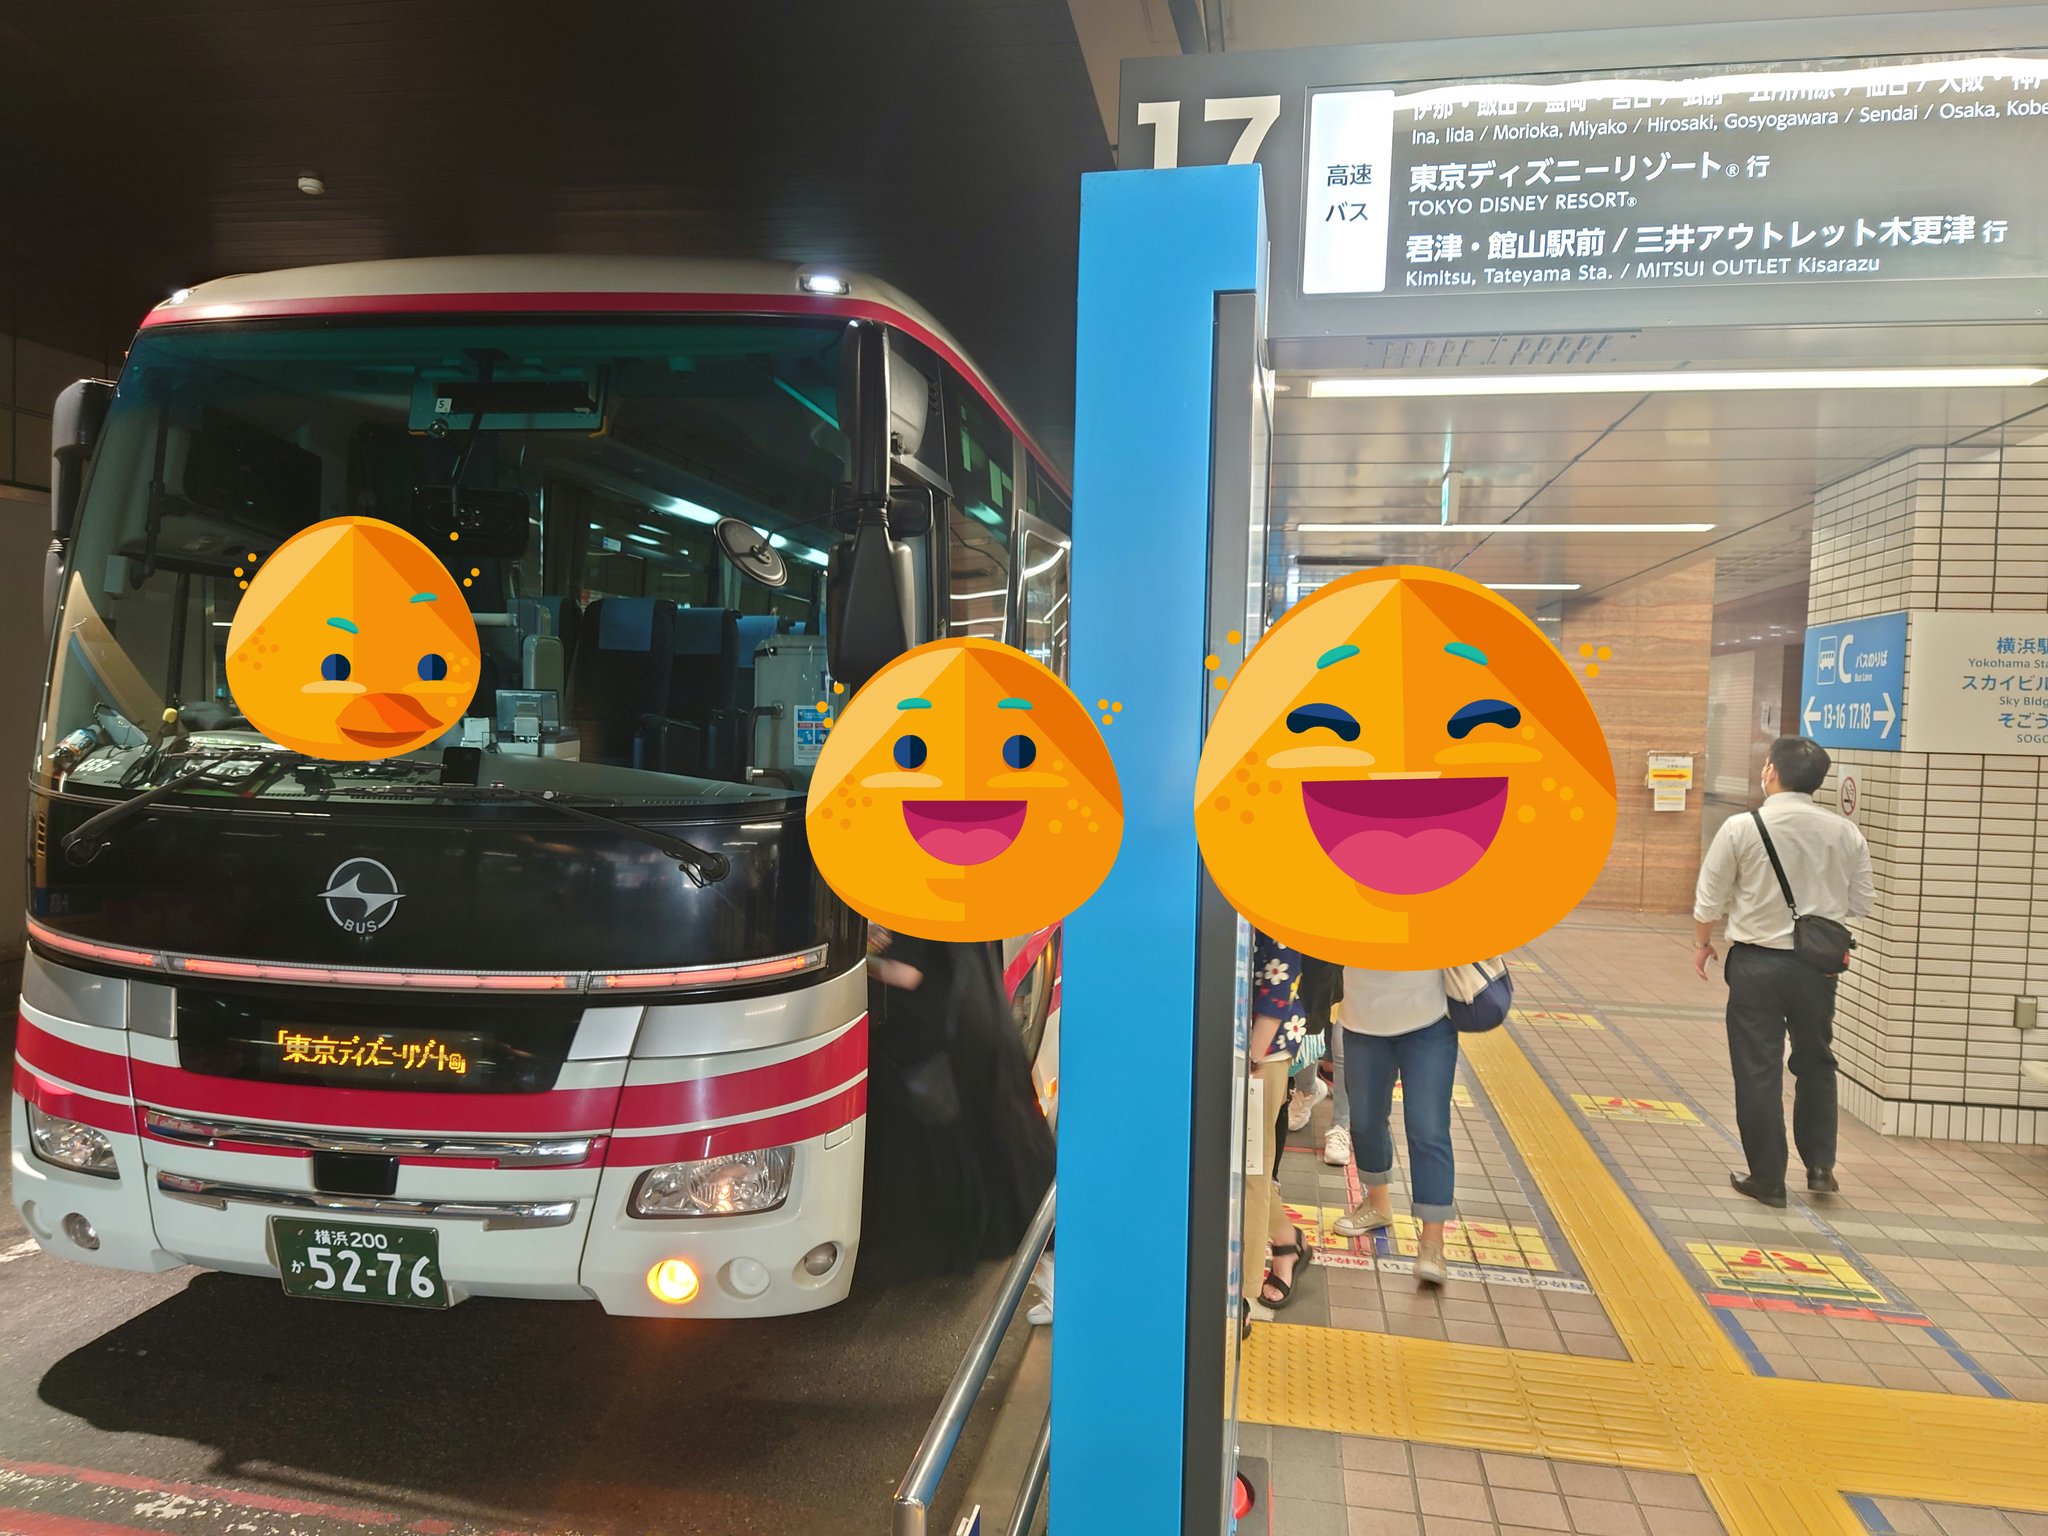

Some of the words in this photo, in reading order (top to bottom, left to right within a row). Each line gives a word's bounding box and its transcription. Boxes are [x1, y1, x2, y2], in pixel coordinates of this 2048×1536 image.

[1137, 94, 1282, 169] 17
[1412, 129, 1440, 145] Ina,
[1445, 126, 1474, 143] Iida
[1493, 122, 1563, 141] Morioka,
[1568, 118, 1628, 140] Miyako
[1647, 114, 1718, 133] Hirosaki,
[1724, 110, 1838, 132] Gosyogawara
[1859, 104, 1918, 123] Sendai
[1939, 101, 2001, 119] Osaka,
[1327, 163, 1373, 187] 高速
[1746, 154, 1771, 178] 行
[1325, 201, 1368, 222] バス
[1408, 198, 1472, 217] TOKYO
[1480, 194, 1549, 214] DISNEY
[1405, 227, 1606, 263] 君津・館山駅前
[1634, 214, 1976, 253] 三井アウトレット木更津
[1405, 269, 1477, 288] Kimitsu,
[1484, 266, 1571, 288] Tateyama
[1578, 264, 1613, 281] Sta.
[1636, 260, 1705, 279] MITSUI
[1712, 257, 1792, 276] OUTLET
[1798, 256, 1881, 275] Kisarazu
[1838, 634, 1854, 684] C
[1855, 650, 1889, 669] バスのりば
[1968, 657, 2031, 669] Yokohama
[1999, 696, 2020, 708] Sky
[1998, 712, 2048, 730] そごう
[343, 919, 378, 934] BUS
[291, 1259, 306, 1274] か
[307, 1246, 435, 1299] 52-76
